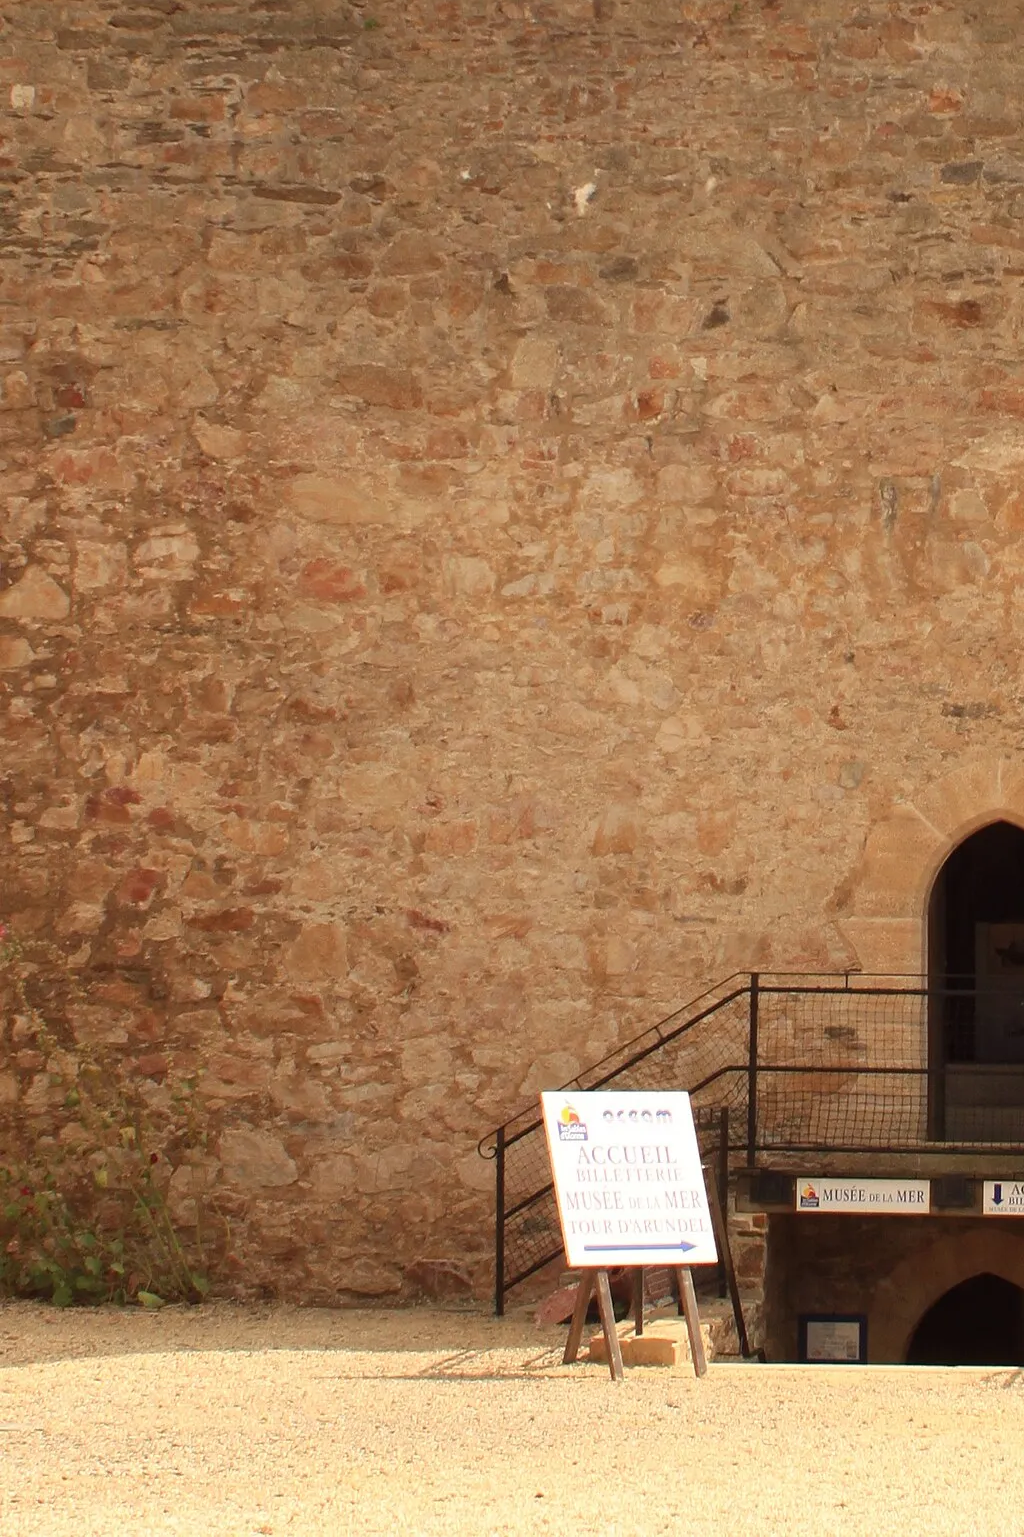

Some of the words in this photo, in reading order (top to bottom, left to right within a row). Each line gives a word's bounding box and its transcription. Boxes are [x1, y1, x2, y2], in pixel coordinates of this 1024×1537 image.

[578, 1145, 677, 1164] ACCUEIL
[576, 1168, 684, 1182] BILLETTERIE
[566, 1184, 624, 1210] MUSÉE
[628, 1196, 642, 1209] DE
[646, 1196, 661, 1209] LA
[664, 1190, 703, 1209] MER
[823, 1185, 866, 1202] MUSÉE
[869, 1193, 880, 1202] DE
[882, 1193, 893, 1202] LA
[896, 1190, 925, 1203] MER
[568, 1220, 613, 1234] TOUR
[618, 1218, 709, 1234] D'ARUNDEL
